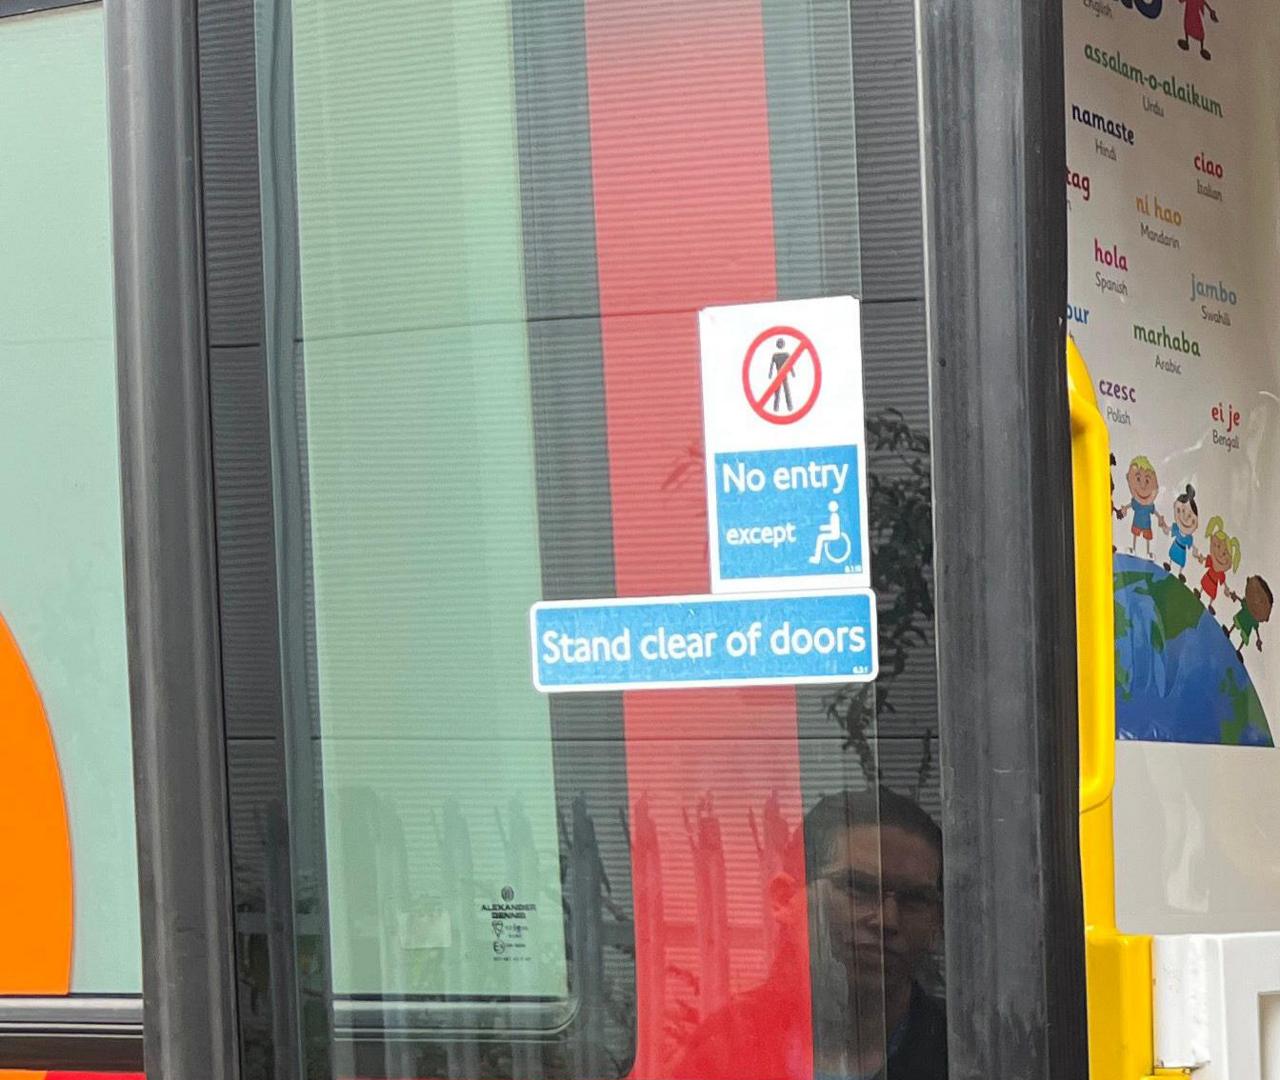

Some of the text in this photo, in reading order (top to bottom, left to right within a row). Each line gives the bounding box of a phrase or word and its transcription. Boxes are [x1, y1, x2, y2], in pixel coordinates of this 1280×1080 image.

[1084, 44, 1223, 118] assalam-o-alaikum
[1142, 95, 1164, 117] Urdu
[1072, 103, 1134, 145] namaste
[1095, 138, 1117, 161] Hindi
[1194, 152, 1223, 178] ciao
[1135, 195, 1182, 226] ni hao
[1140, 222, 1180, 249] Mandarin
[1094, 237, 1128, 271] hola
[1095, 271, 1128, 296] Spanish
[1190, 273, 1237, 305] jambo
[1133, 323, 1200, 357] marhaba
[1155, 355, 1182, 375] Arabic
[1099, 378, 1137, 403] czesc
[1106, 405, 1132, 426] Polish
[1211, 402, 1241, 432] ei je
[1212, 429, 1240, 452] Bengali
[722, 460, 849, 494] No entry
[726, 523, 797, 547] except
[542, 621, 866, 664] Stand clear of doors
